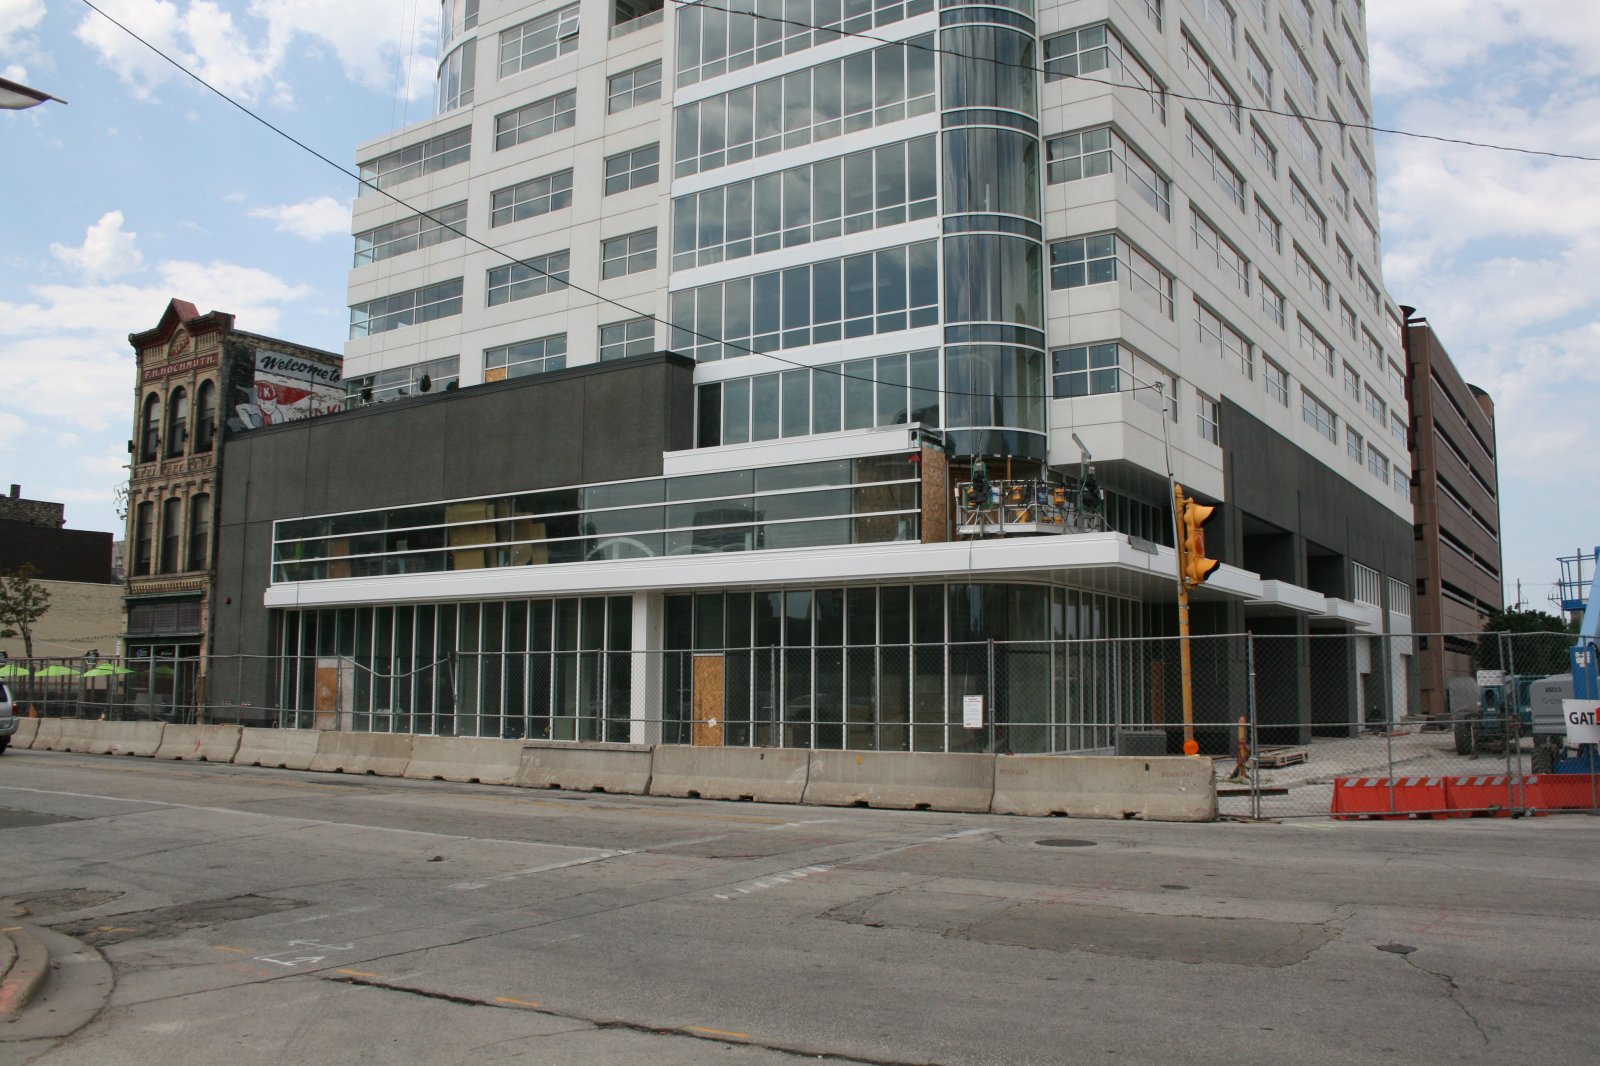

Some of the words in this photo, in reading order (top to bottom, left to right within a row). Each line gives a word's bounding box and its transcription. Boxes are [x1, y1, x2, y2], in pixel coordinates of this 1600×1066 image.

[260, 356, 329, 379] Welcome
[329, 368, 340, 383] to
[263, 387, 271, 398] K
[1569, 711, 1600, 725] GAT
